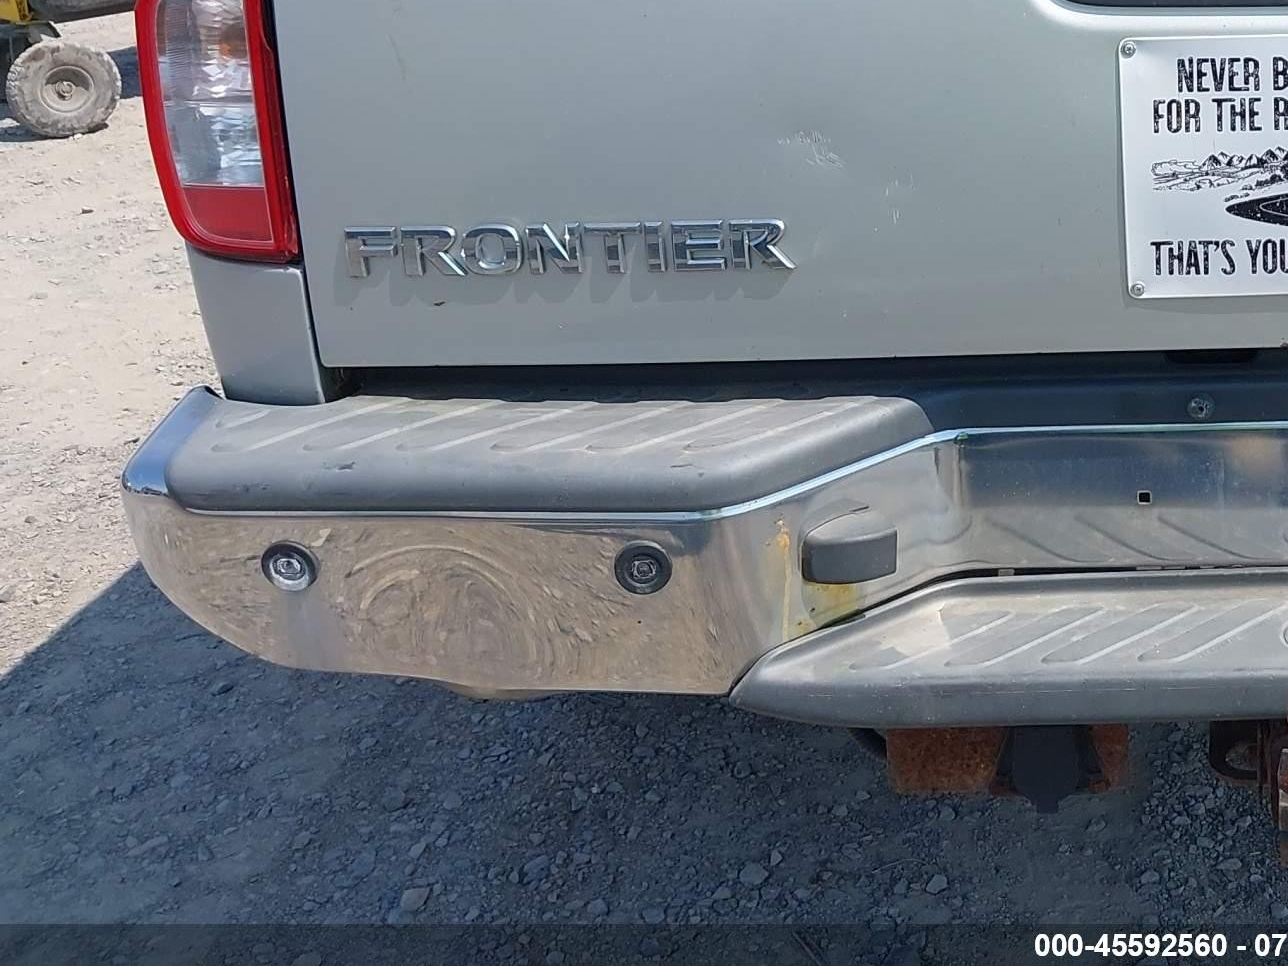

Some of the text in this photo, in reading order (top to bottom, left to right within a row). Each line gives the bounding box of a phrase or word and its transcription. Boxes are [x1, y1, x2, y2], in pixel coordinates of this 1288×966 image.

[1178, 57, 1259, 92] NEVER
[1154, 99, 1200, 133] FOR
[1212, 98, 1262, 131] THE
[344, 218, 798, 277] FRONTIER
[1150, 240, 1235, 275] THAT'S
